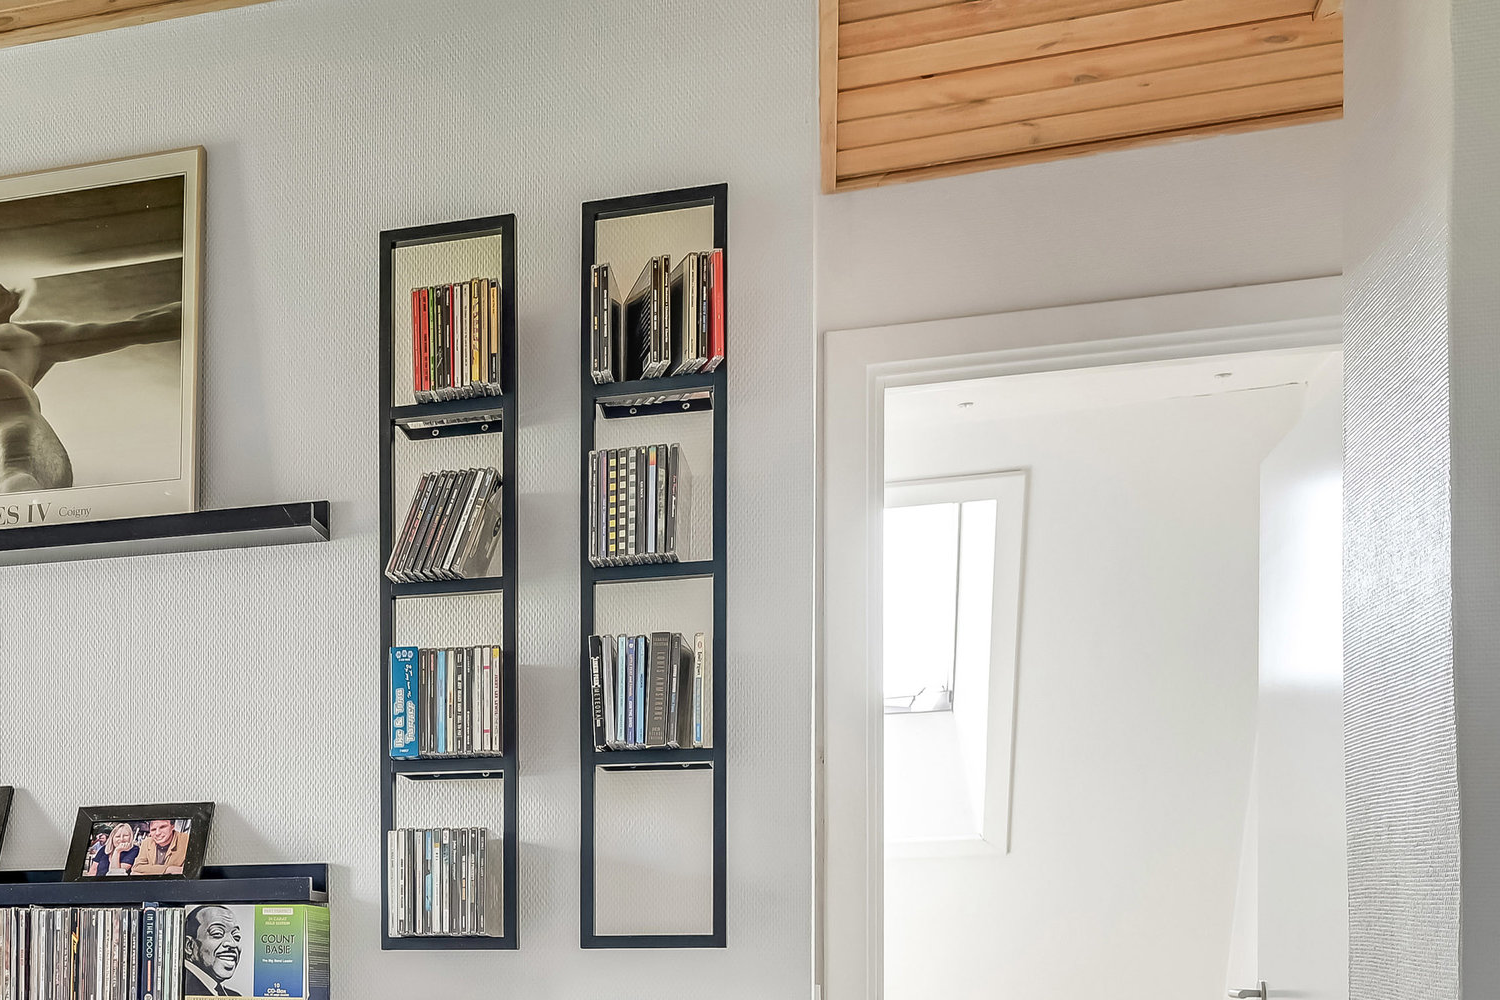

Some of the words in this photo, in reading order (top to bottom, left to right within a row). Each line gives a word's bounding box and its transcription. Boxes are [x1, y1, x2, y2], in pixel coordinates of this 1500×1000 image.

[26, 502, 52, 524] IV
[58, 505, 92, 519] Coigny
[261, 934, 295, 943] COUNT
[265, 945, 291, 954] BASIE
